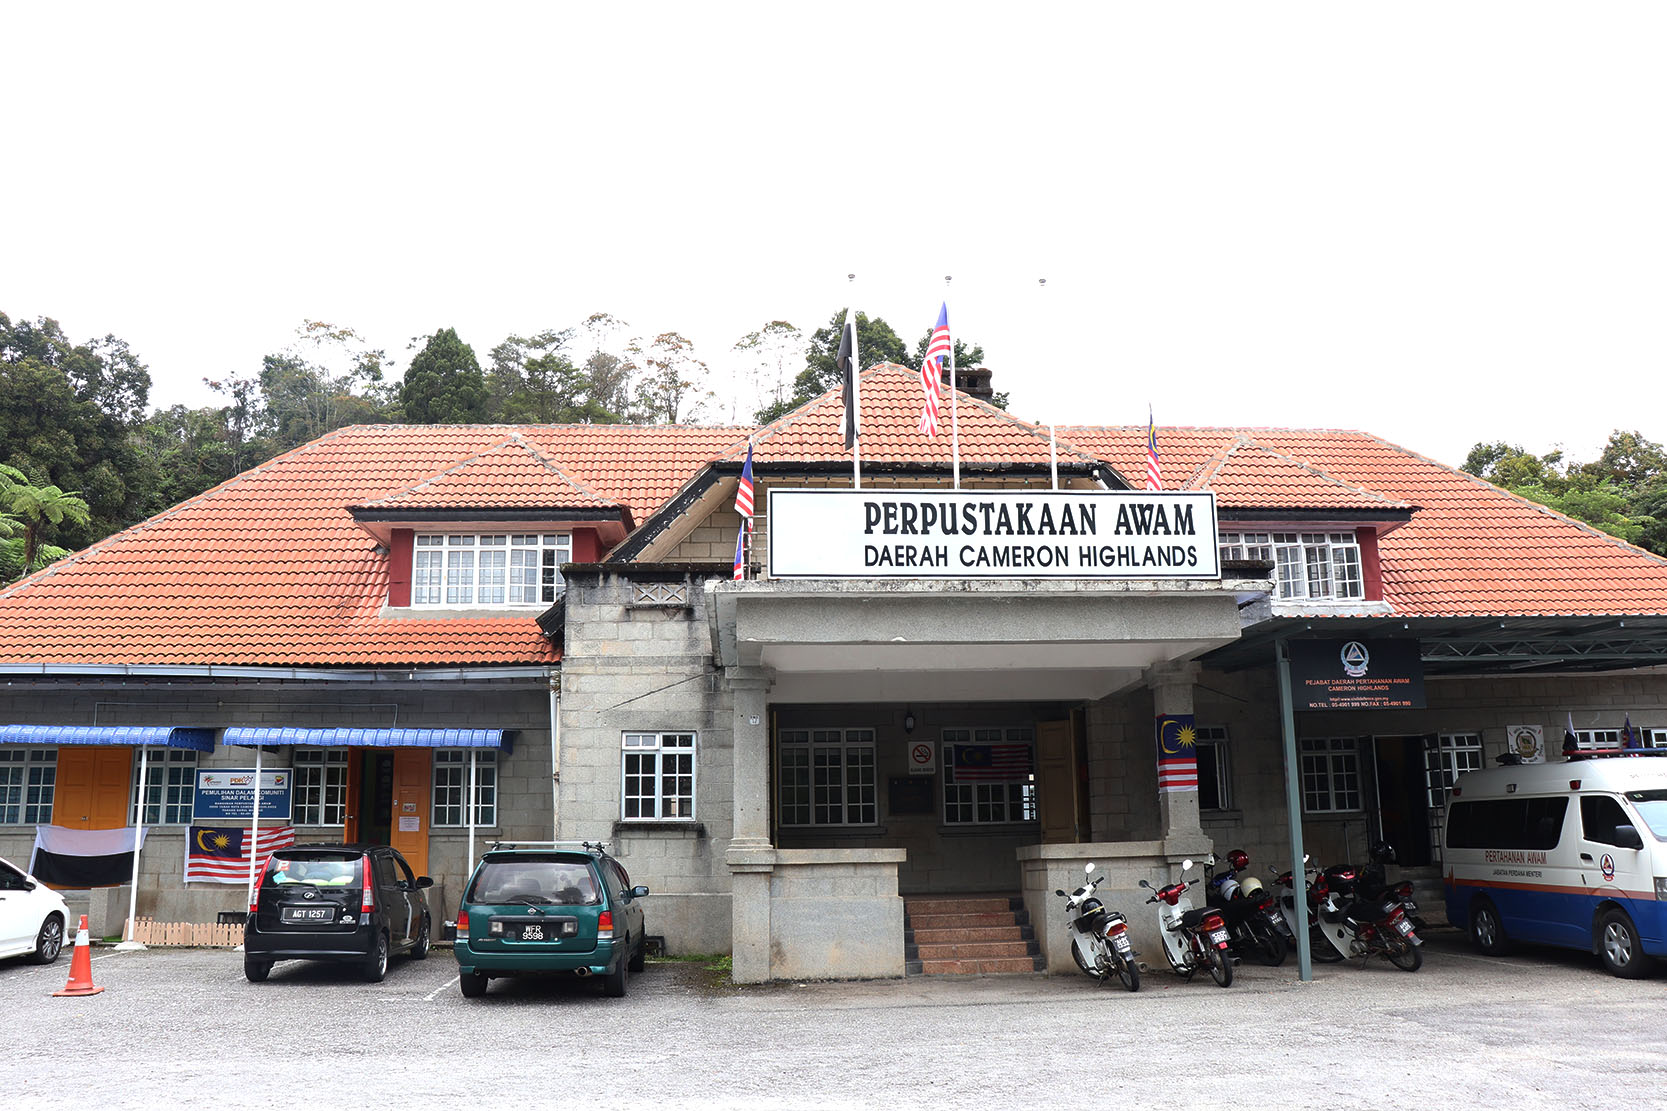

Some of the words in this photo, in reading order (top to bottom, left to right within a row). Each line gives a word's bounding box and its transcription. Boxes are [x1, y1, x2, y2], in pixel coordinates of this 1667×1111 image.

[864, 502, 1097, 536] PERPUSTAKAAN
[1114, 503, 1197, 537] AWAM
[865, 545, 949, 567] DAERAH
[960, 545, 1069, 568] CAMERON
[1079, 545, 1198, 567] HIGHLANDS
[1485, 850, 1525, 864] PERTAHANAN
[1527, 851, 1547, 865] AWAM
[292, 910, 306, 918] AGT
[308, 910, 326, 918] 1257
[522, 932, 544, 940] 9598
